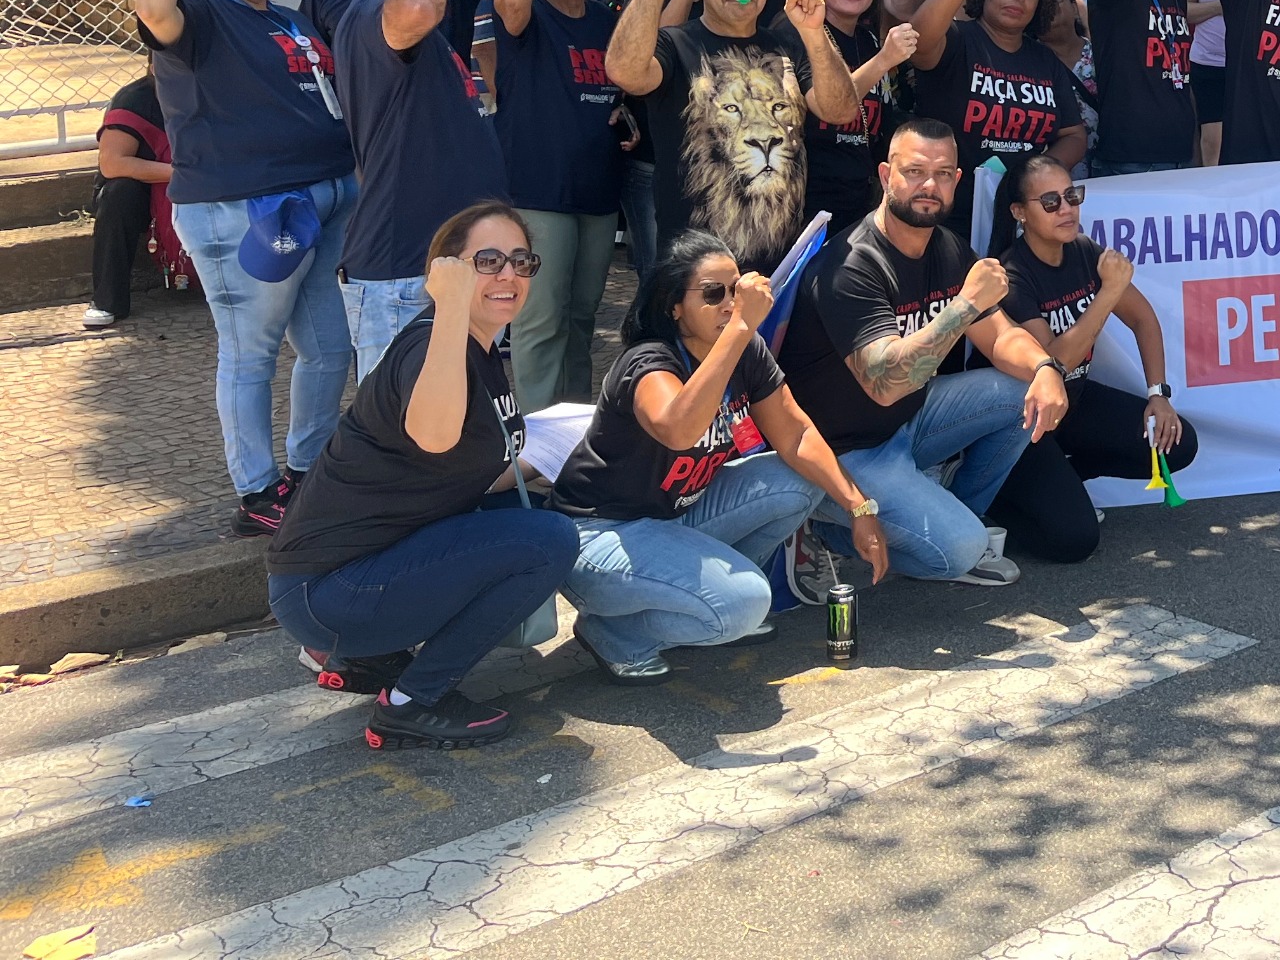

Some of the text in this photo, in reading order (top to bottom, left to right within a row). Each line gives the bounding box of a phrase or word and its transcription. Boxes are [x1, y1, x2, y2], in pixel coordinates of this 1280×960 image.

[970, 71, 1057, 108] FAÇA SUA
[963, 99, 1056, 144] PARTE
[989, 140, 1023, 150] SINSAÚDE
